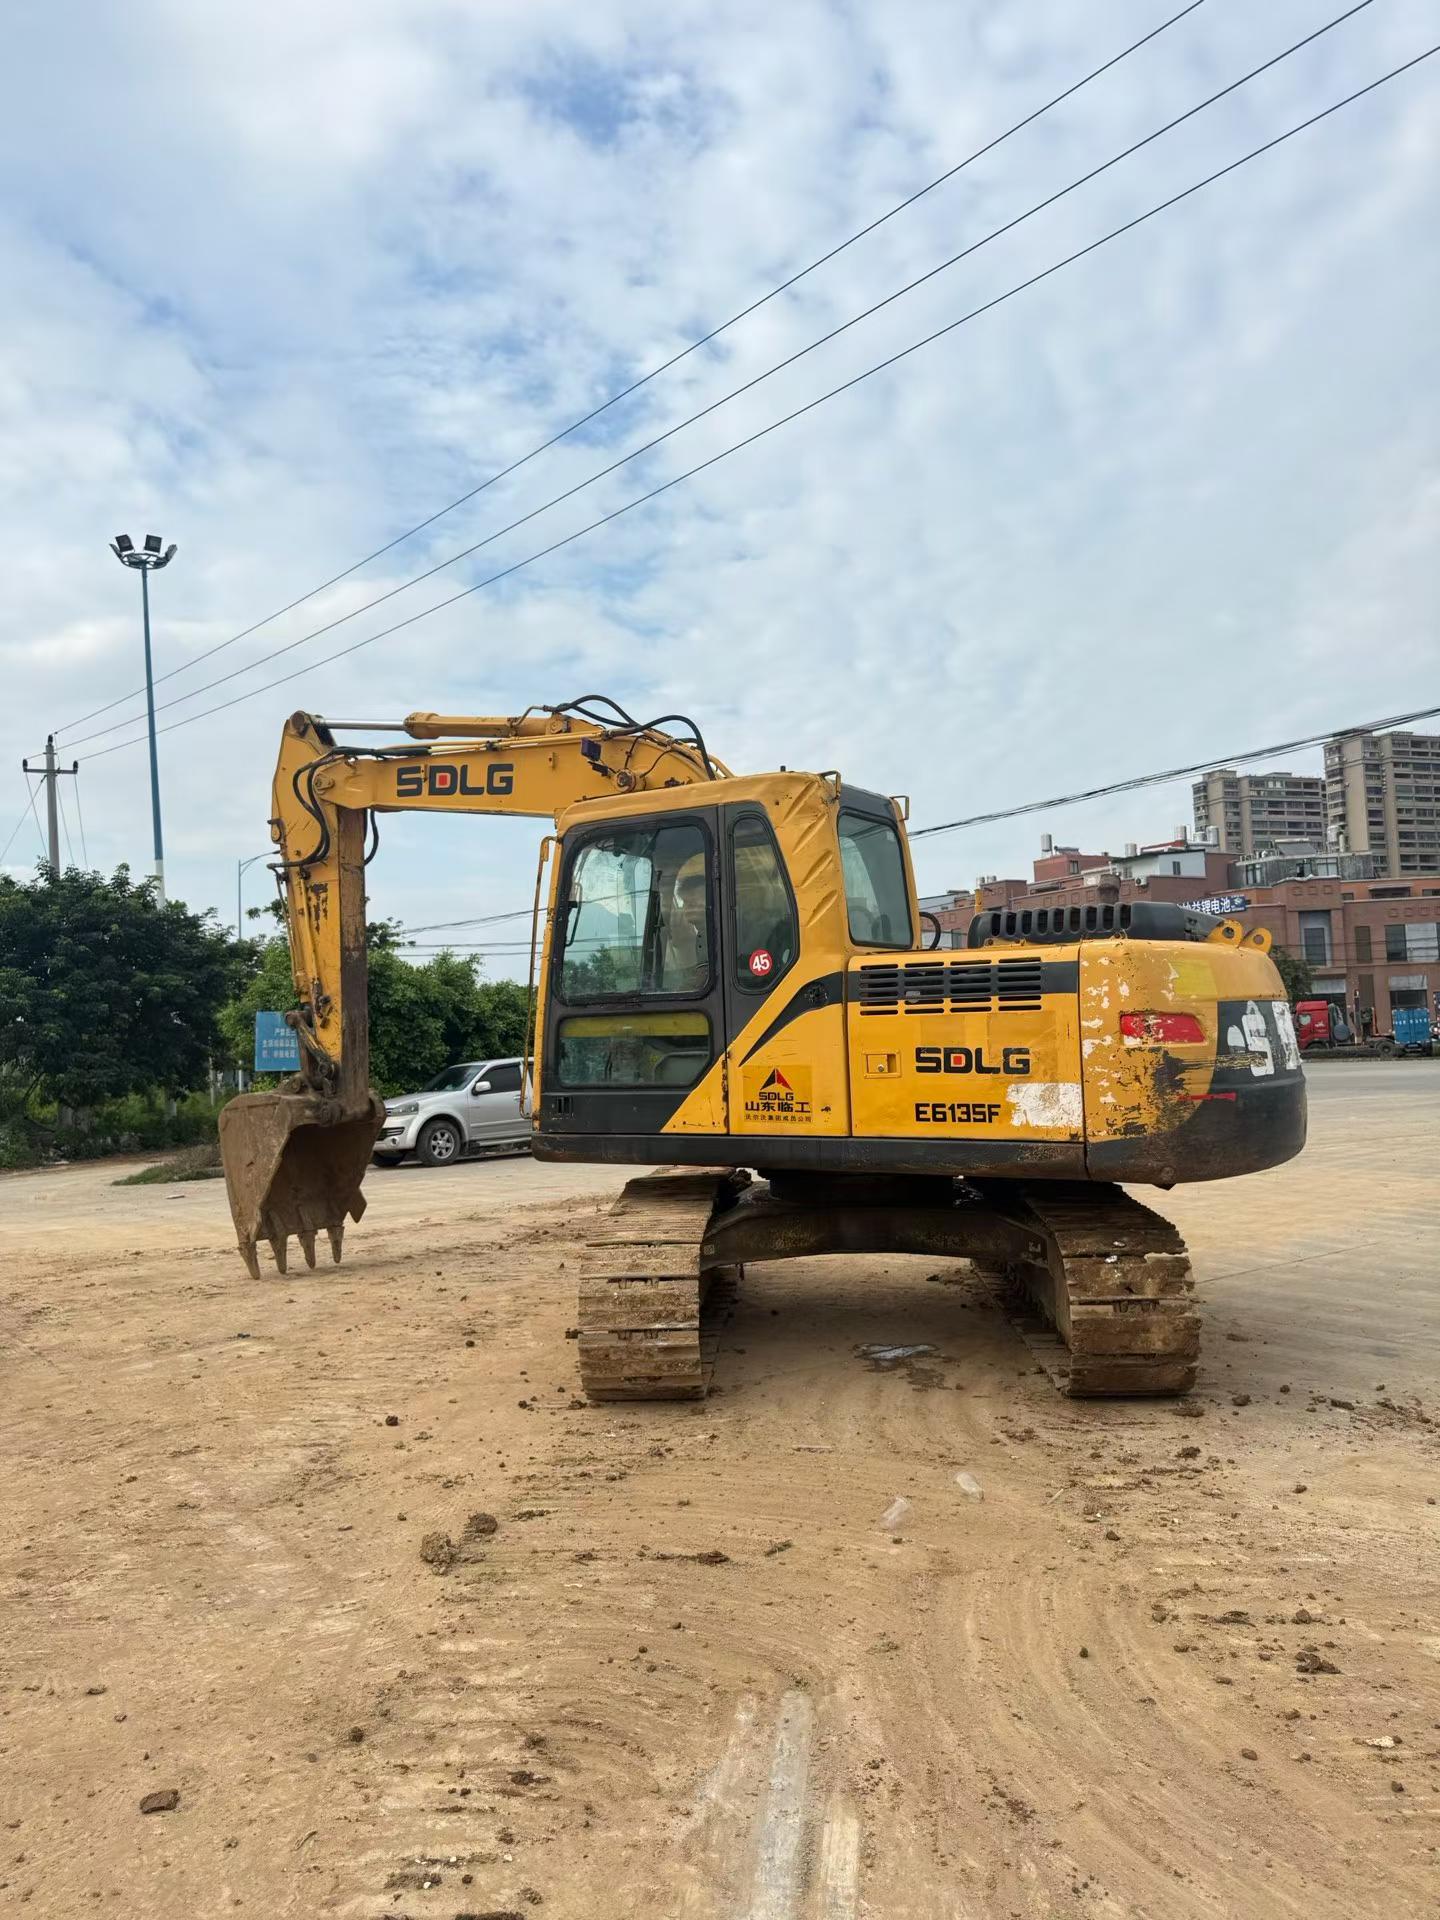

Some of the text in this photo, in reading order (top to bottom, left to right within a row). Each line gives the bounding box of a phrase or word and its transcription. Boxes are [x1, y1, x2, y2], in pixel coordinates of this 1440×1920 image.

[397, 763, 514, 797] SDLG
[752, 953, 770, 971] 45
[915, 1047, 1030, 1074] SDLG
[759, 1092, 794, 1101] SDLG
[745, 1101, 811, 1113] 山东临工
[915, 1103, 1001, 1123] E6135F
